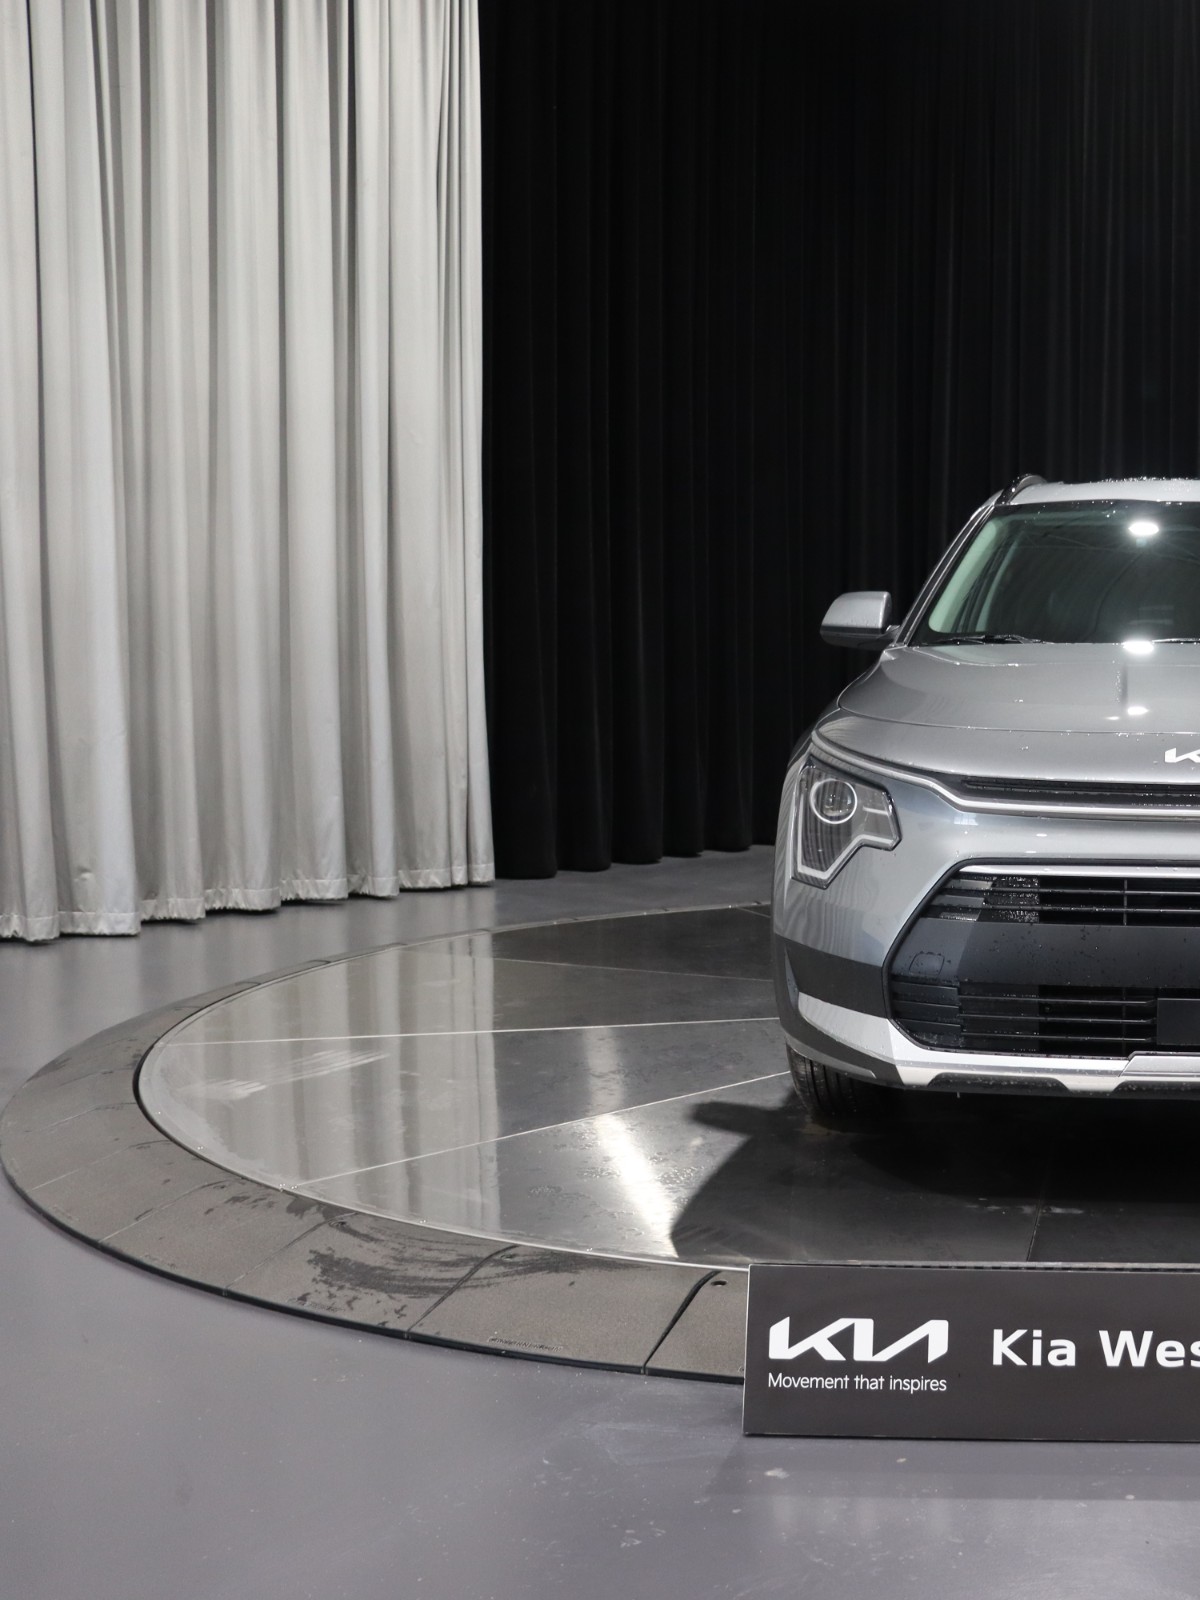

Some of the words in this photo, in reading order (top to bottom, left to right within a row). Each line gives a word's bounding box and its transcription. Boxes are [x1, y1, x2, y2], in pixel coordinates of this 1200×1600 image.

[992, 1328, 1077, 1367] Kia
[768, 1372, 850, 1390] Movement
[853, 1374, 886, 1391] that
[888, 1374, 947, 1395] inspires
